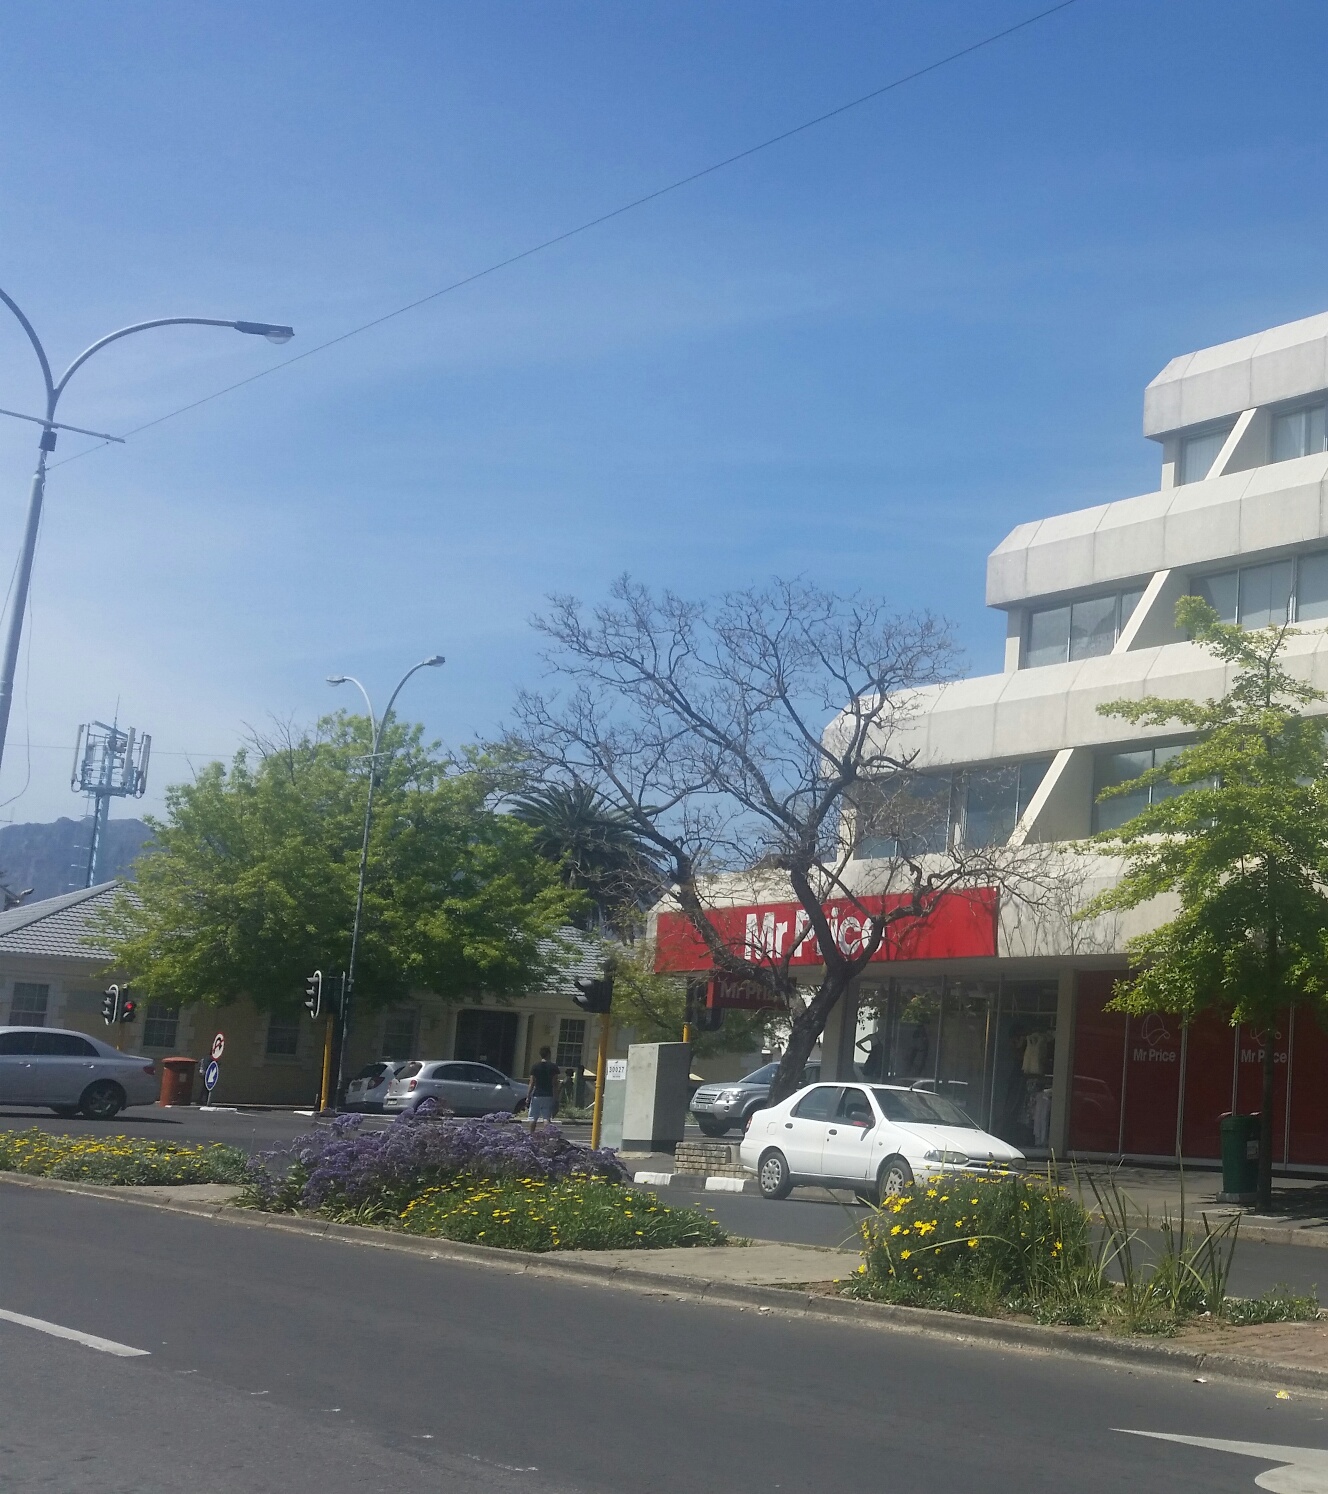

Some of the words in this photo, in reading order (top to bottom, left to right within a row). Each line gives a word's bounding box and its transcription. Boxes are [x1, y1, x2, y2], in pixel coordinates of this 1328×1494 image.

[744, 911, 788, 960] Mr
[793, 906, 886, 957] Pice
[720, 980, 741, 999] Mr
[1133, 1048, 1147, 1062] Mr
[1149, 1048, 1177, 1062] Price
[1241, 1049, 1255, 1063] Mr
[1257, 1049, 1287, 1064] Pce
